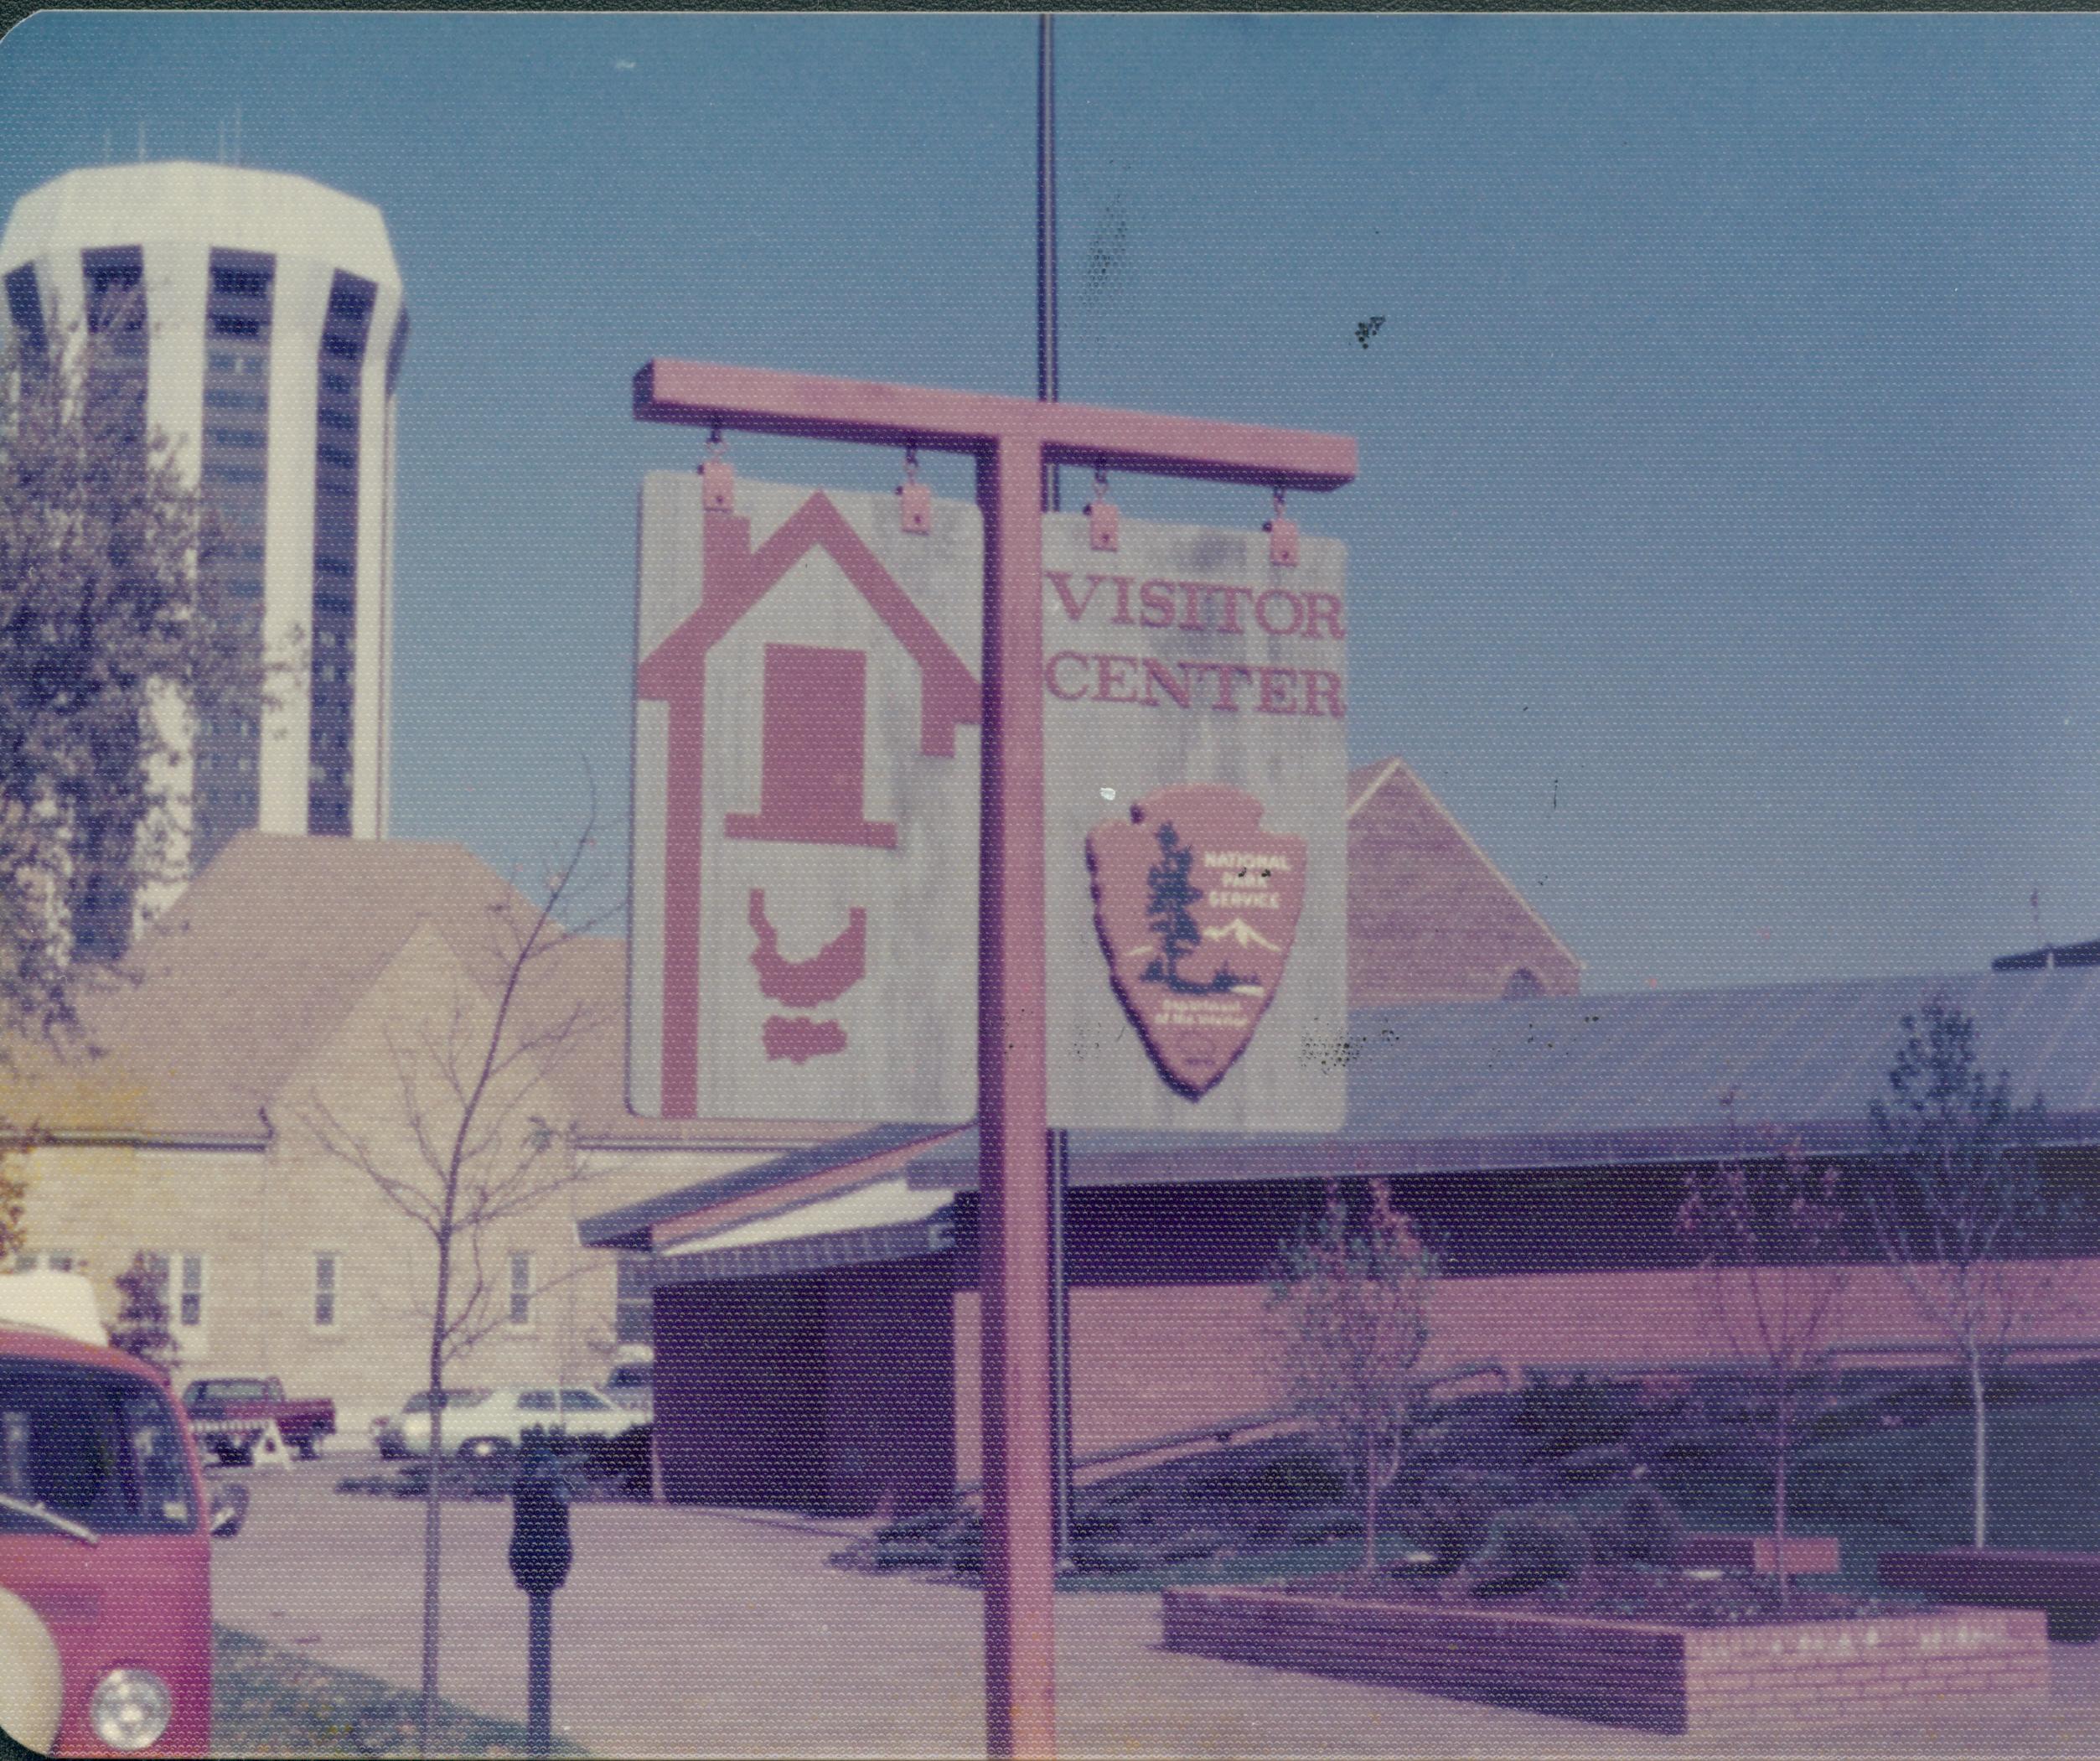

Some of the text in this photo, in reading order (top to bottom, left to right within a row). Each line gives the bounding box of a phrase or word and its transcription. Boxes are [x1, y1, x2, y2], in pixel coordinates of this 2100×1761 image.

[1044, 570, 1346, 640] VISITOR
[1044, 650, 1346, 718] CENTER
[1203, 852, 1292, 871] NATIONAL
[1208, 890, 1280, 909] SERVICE
